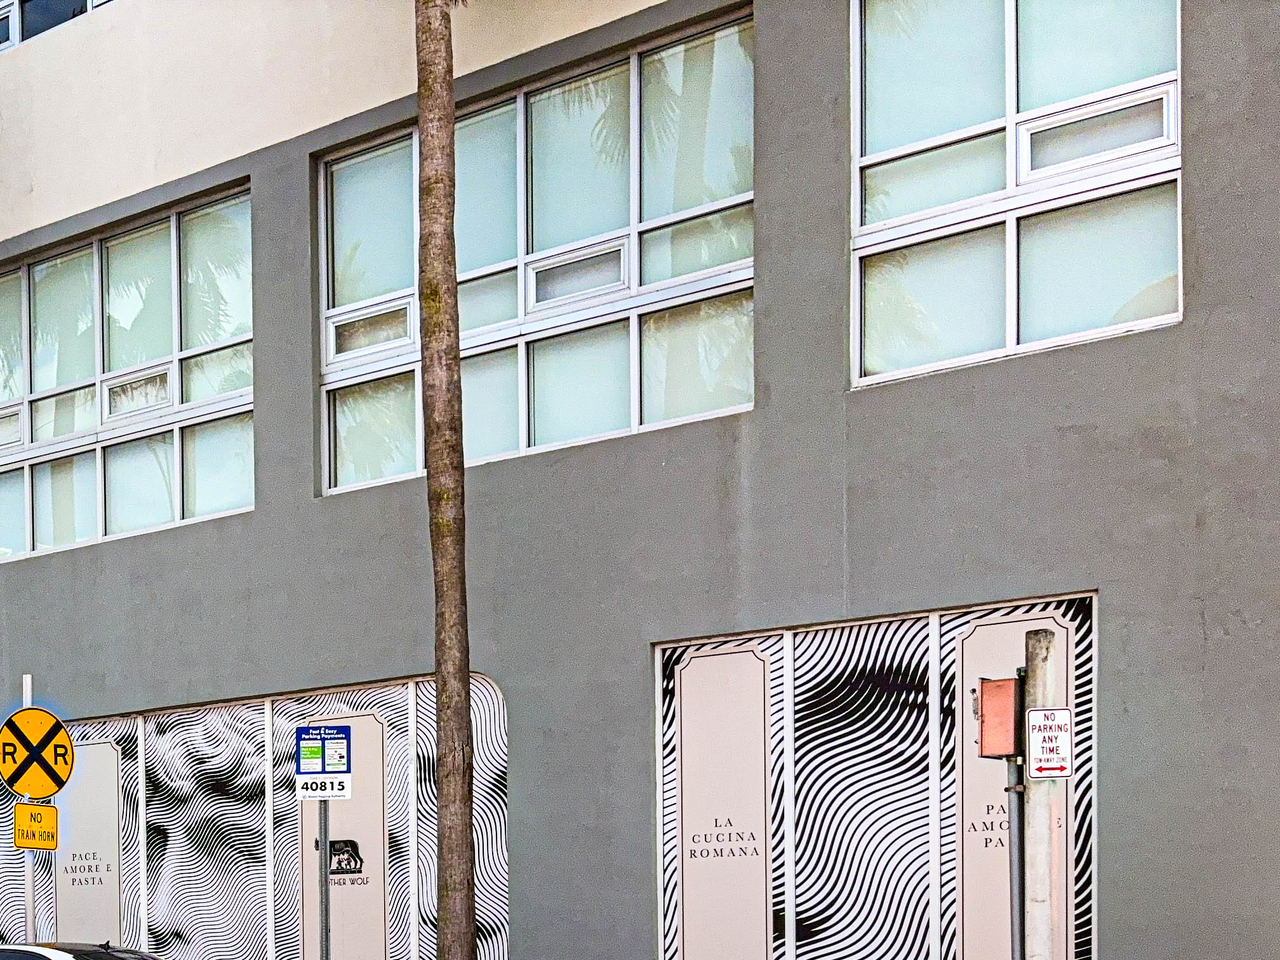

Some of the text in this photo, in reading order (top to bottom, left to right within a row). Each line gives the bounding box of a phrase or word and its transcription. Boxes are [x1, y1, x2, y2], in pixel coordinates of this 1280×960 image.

[1043, 712, 1056, 722] NO
[1031, 724, 1069, 733] PARKING
[1041, 735, 1059, 744] ANY
[2, 742, 69, 765] R R
[1041, 746, 1060, 755] TIME
[301, 781, 345, 791] 40815
[986, 804, 1007, 815] PA
[30, 811, 43, 823] NO
[714, 818, 733, 828] LA
[966, 820, 1010, 832] AMO
[17, 828, 55, 842] TRAIN HORN
[691, 832, 756, 844] CUCINA
[72, 852, 102, 862] PACE,
[689, 847, 759, 858] ROMANA
[63, 863, 112, 874] AMORE E
[71, 876, 103, 886] PASTA
[329, 876, 369, 886] THER WOLF
